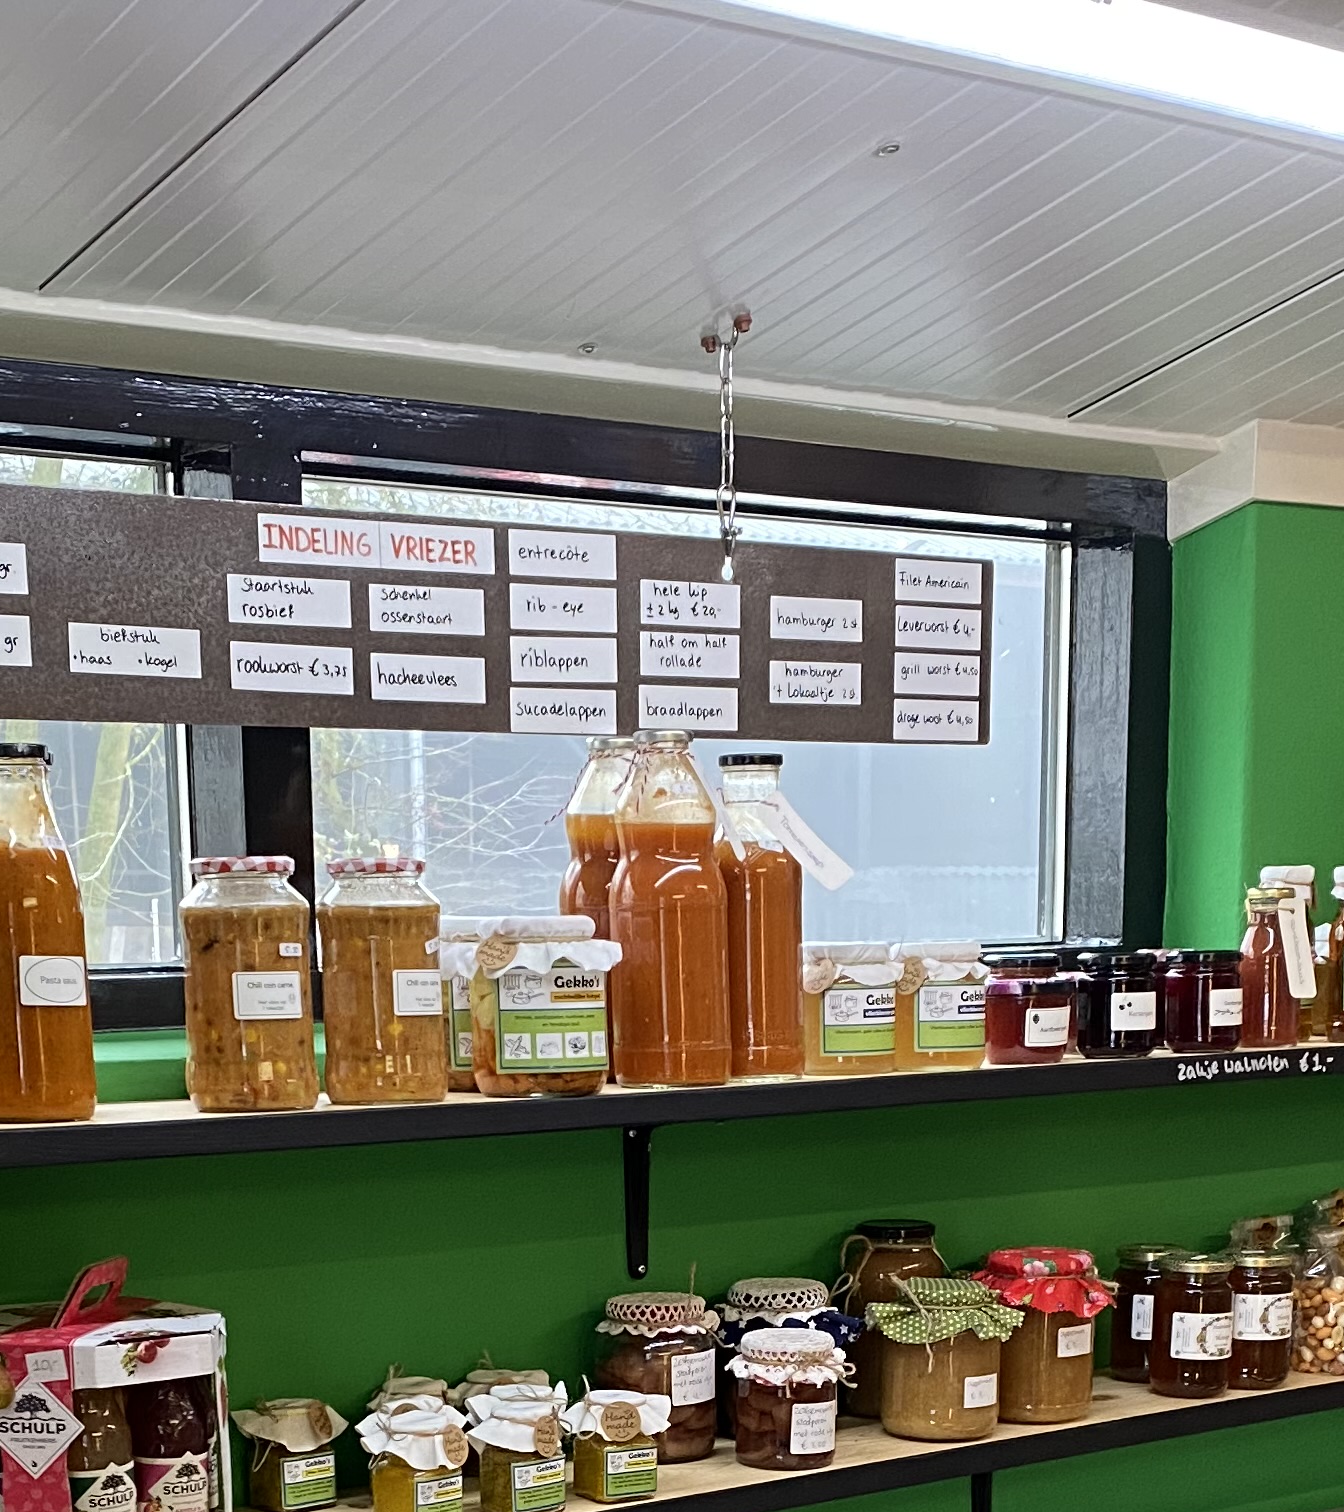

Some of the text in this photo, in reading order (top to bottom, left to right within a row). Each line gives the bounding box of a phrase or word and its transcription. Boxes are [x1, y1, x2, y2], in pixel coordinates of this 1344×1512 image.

[262, 522, 478, 566] INDELING VRIEZER
[517, 544, 590, 563] entrecôte
[899, 570, 970, 590] Filet Americain
[652, 581, 708, 601] hele kip
[241, 602, 295, 620] rosbief
[526, 595, 584, 617] rib eye
[380, 611, 453, 625] ossenstaart
[776, 608, 837, 632] hamburger
[99, 628, 161, 645] biefstuk
[649, 632, 675, 649] half
[681, 638, 699, 648] om
[236, 656, 304, 675] rookworst
[520, 646, 589, 673] riblappen
[659, 655, 703, 668] rollade
[784, 662, 844, 684] hamburger
[514, 701, 607, 722] sucadelappen
[646, 696, 724, 720] braadlappen
[1177, 1059, 1220, 1081] Zakje
[1224, 1054, 1290, 1075] walnoten
[605, 1409, 637, 1422] Hand
[606, 1420, 635, 1430] made
[0, 1421, 67, 1435] SCHULP
[163, 1480, 207, 1495] SCHULP
[88, 1490, 135, 1508] SCHULP
